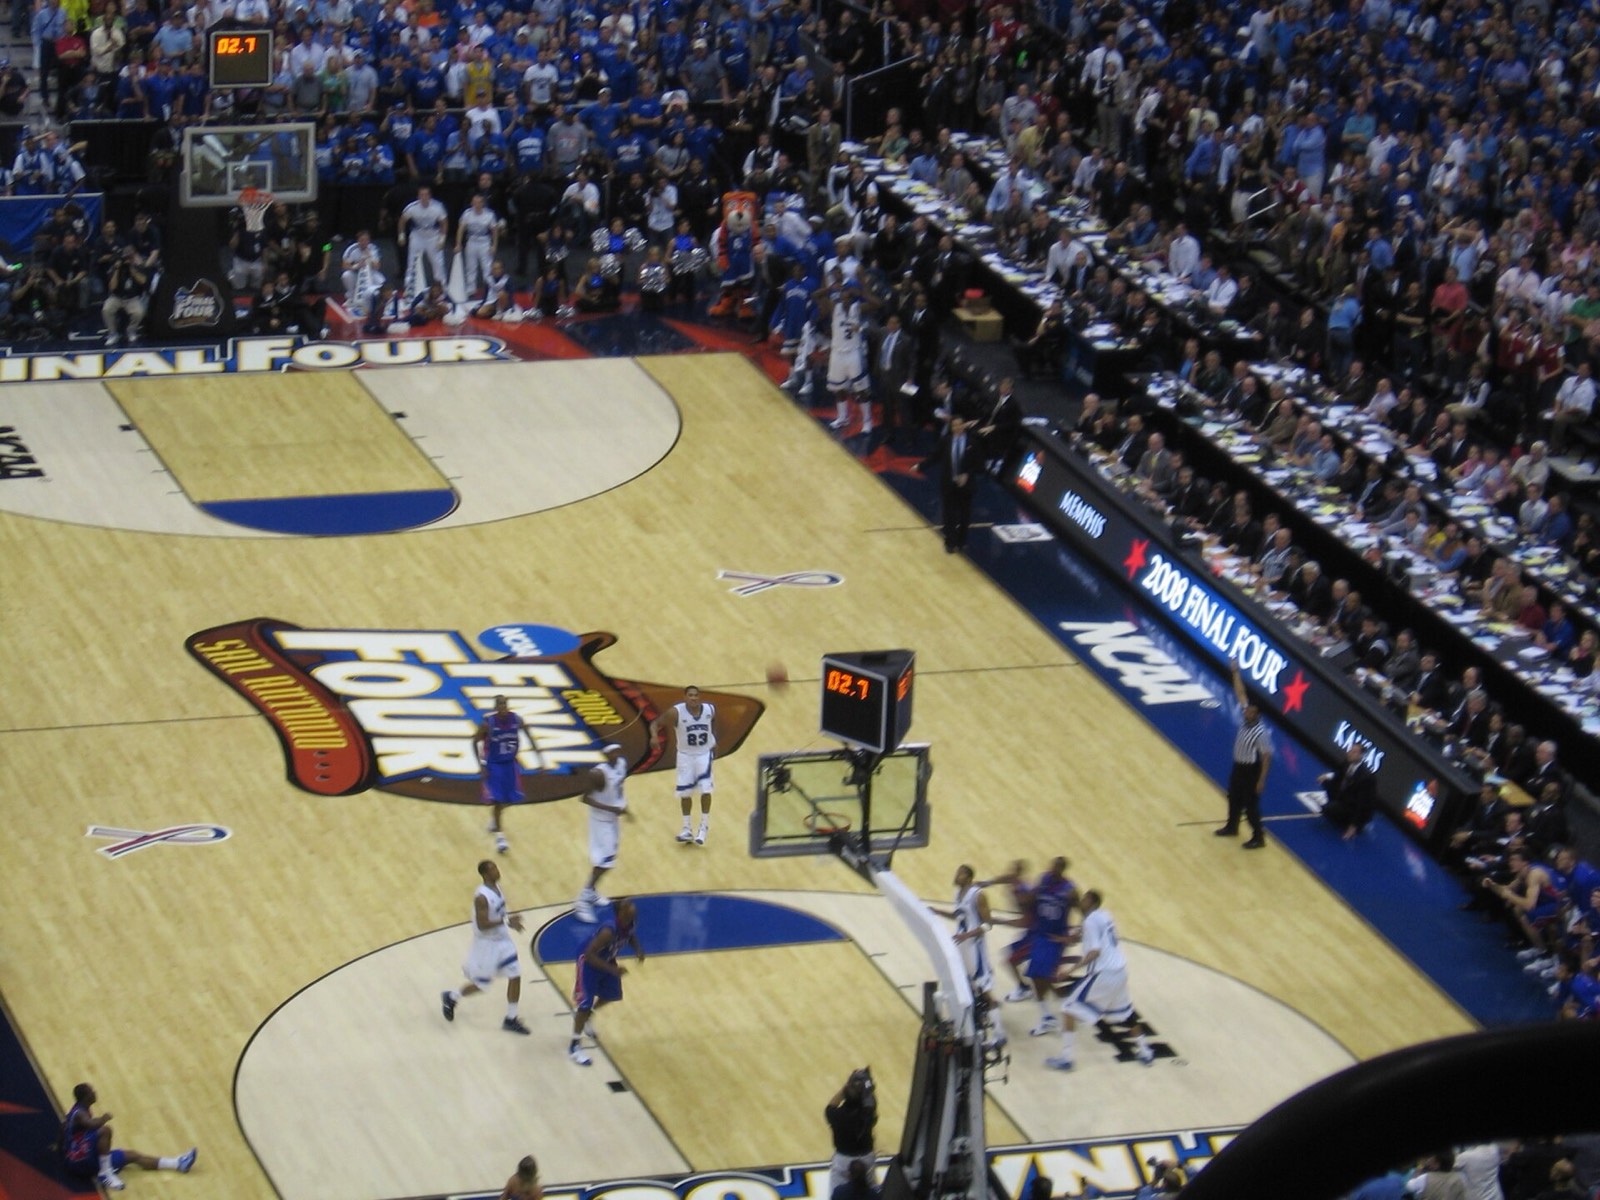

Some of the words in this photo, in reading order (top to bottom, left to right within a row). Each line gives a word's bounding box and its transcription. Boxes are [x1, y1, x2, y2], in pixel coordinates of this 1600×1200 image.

[236, 337, 497, 373] FOUR
[494, 627, 543, 657] NCAA
[1058, 620, 1216, 706] NCAA
[1141, 554, 1190, 612] 2008
[1180, 584, 1237, 654] FINAL
[1230, 624, 1285, 695] FOUR
[193, 638, 275, 675] SAN
[240, 674, 348, 749] ANTONIO
[272, 630, 482, 778] FOUR
[441, 663, 608, 770] FINAL
[560, 689, 625, 726] 2008
[687, 732, 708, 746] 23
